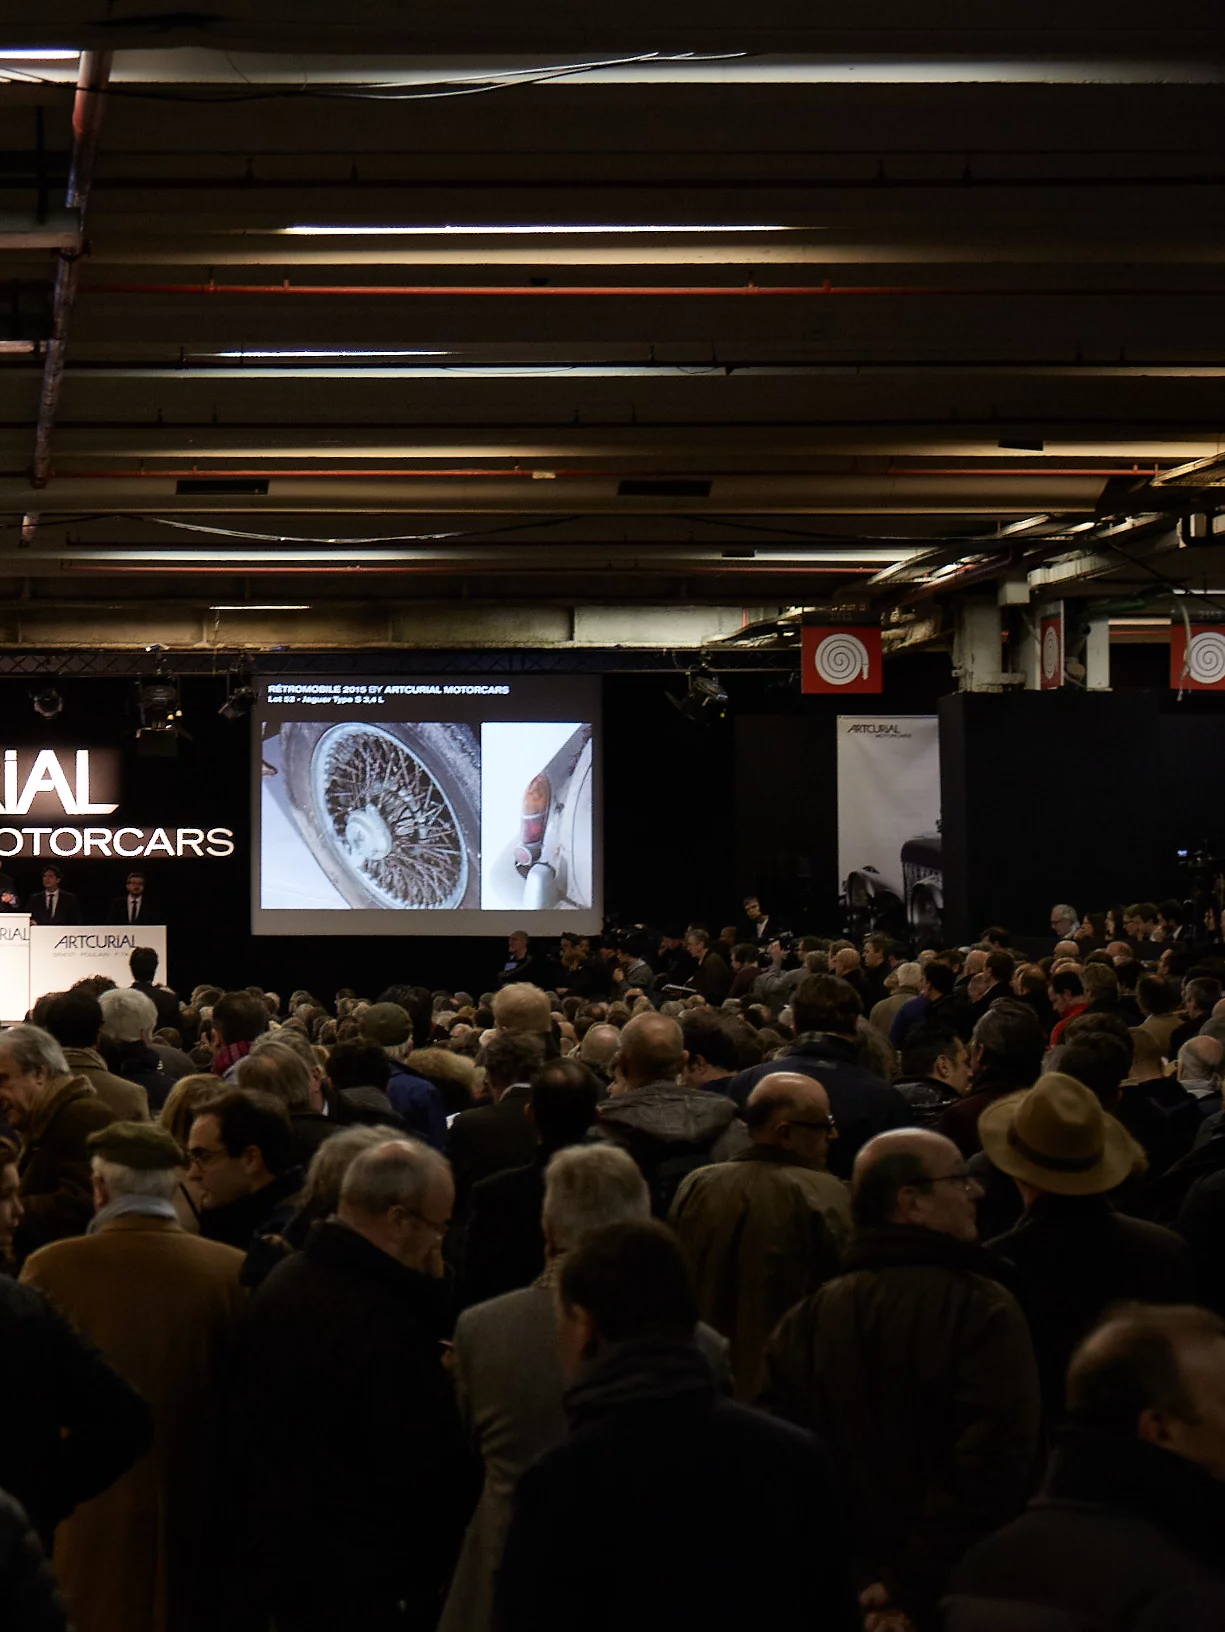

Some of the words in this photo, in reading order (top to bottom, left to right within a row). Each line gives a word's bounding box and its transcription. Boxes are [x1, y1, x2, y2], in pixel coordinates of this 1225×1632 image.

[368, 685, 383, 694] BY
[383, 685, 443, 694] ARTCURIAL
[443, 685, 510, 694] MOTORCARS
[267, 695, 283, 703] Lot
[333, 695, 354, 705] Type
[354, 695, 363, 703] S
[378, 695, 385, 703] L
[847, 724, 901, 734] ARTCURIAL
[54, 934, 137, 949] ARTCURIAL
